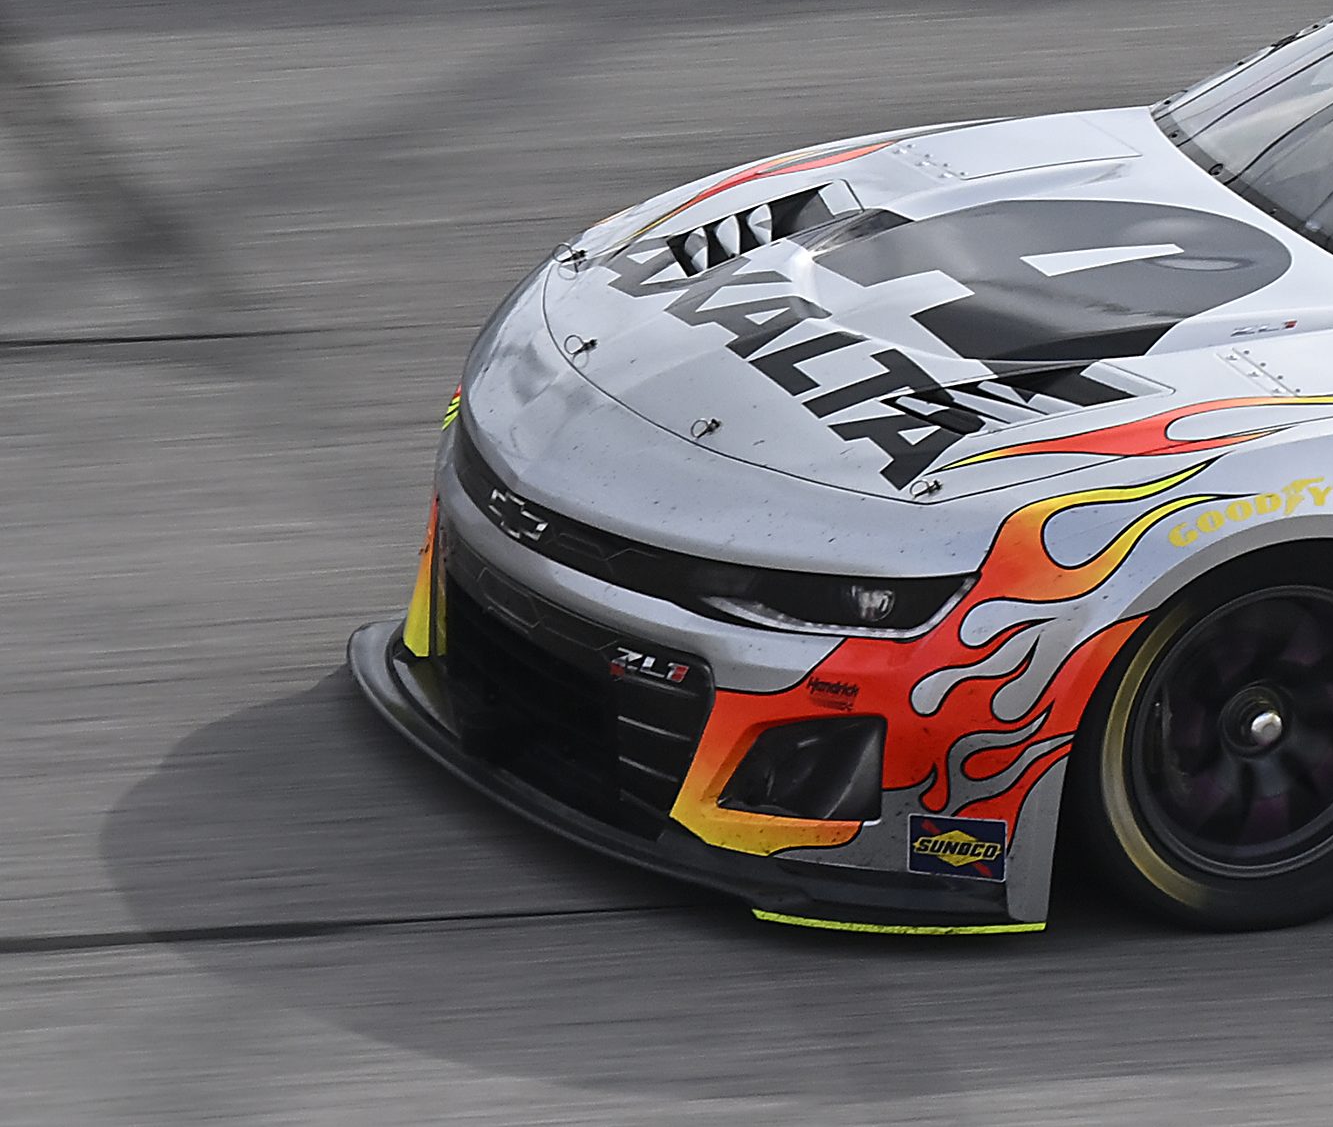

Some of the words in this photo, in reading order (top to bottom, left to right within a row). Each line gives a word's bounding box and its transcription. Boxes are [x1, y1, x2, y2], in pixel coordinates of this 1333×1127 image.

[605, 235, 985, 492] AXALTA
[611, 647, 689, 682] ZL1
[915, 838, 999, 859] SUNOCO
